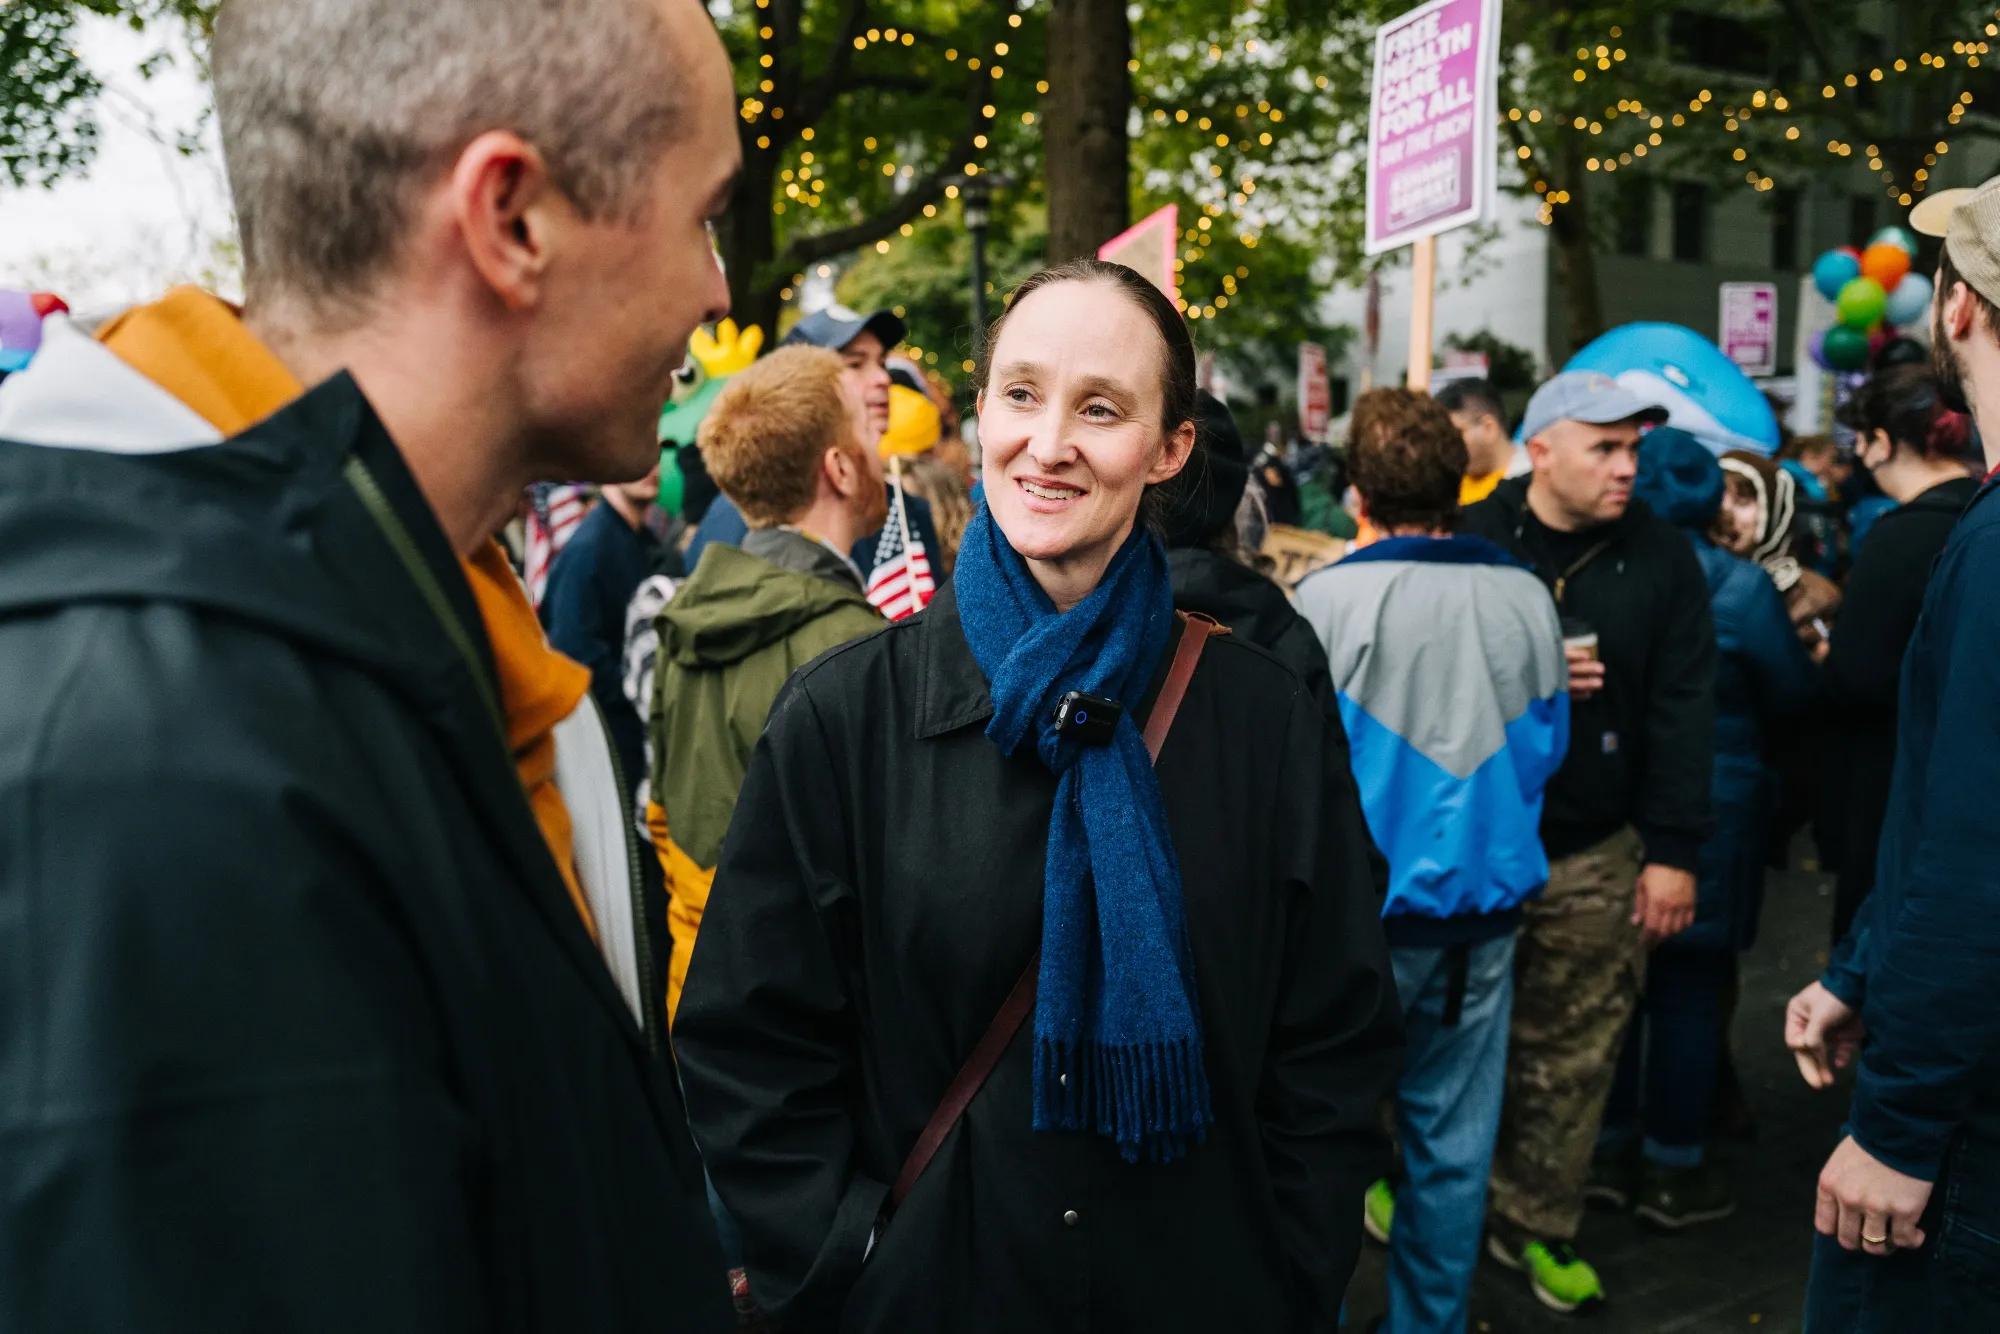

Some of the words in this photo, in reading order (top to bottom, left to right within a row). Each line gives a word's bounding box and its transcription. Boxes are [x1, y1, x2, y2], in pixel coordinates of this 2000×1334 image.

[1382, 21, 1473, 87] HEALTH
[1385, 10, 1442, 57] FREE
[1379, 99, 1426, 142] FOR
[1427, 77, 1473, 120] ALL
[1380, 64, 1442, 113] CARE
